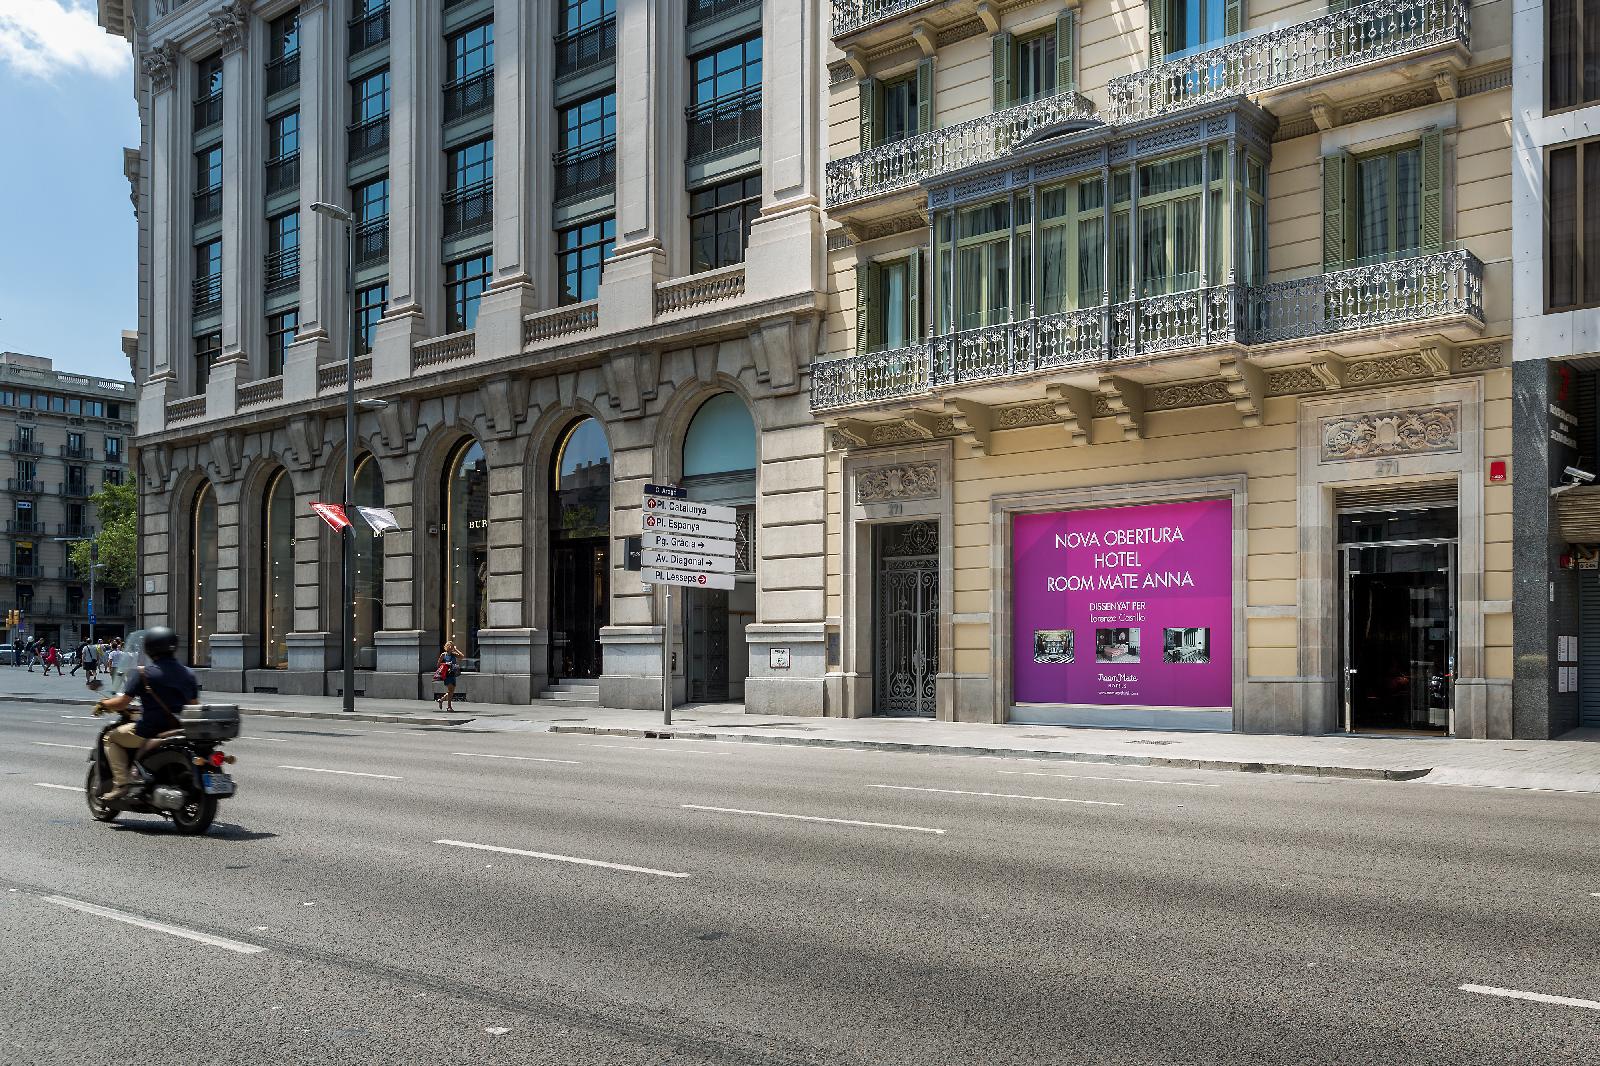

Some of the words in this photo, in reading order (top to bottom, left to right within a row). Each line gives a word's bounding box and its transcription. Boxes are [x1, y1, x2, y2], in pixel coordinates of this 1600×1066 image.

[1376, 460, 1399, 474] 271
[656, 500, 667, 510] Pl.
[669, 501, 707, 516] Catalunya
[656, 517, 666, 527] Pl.
[669, 519, 700, 532] Espanya
[655, 535, 669, 547] Pg.
[1055, 531, 1100, 549] NOVA
[1103, 525, 1185, 546] OBERTURA
[655, 553, 668, 563] Av.
[670, 554, 704, 567] Diagonal
[1094, 551, 1142, 569] HOTEL
[655, 570, 665, 580] Pl.
[666, 571, 697, 584] Lesseps
[1047, 575, 1095, 592] ROOM
[1097, 573, 1138, 590] MATE
[1142, 570, 1195, 589] ANNA
[1089, 602, 1131, 611] DISSENYAT
[1132, 601, 1146, 610] PER
